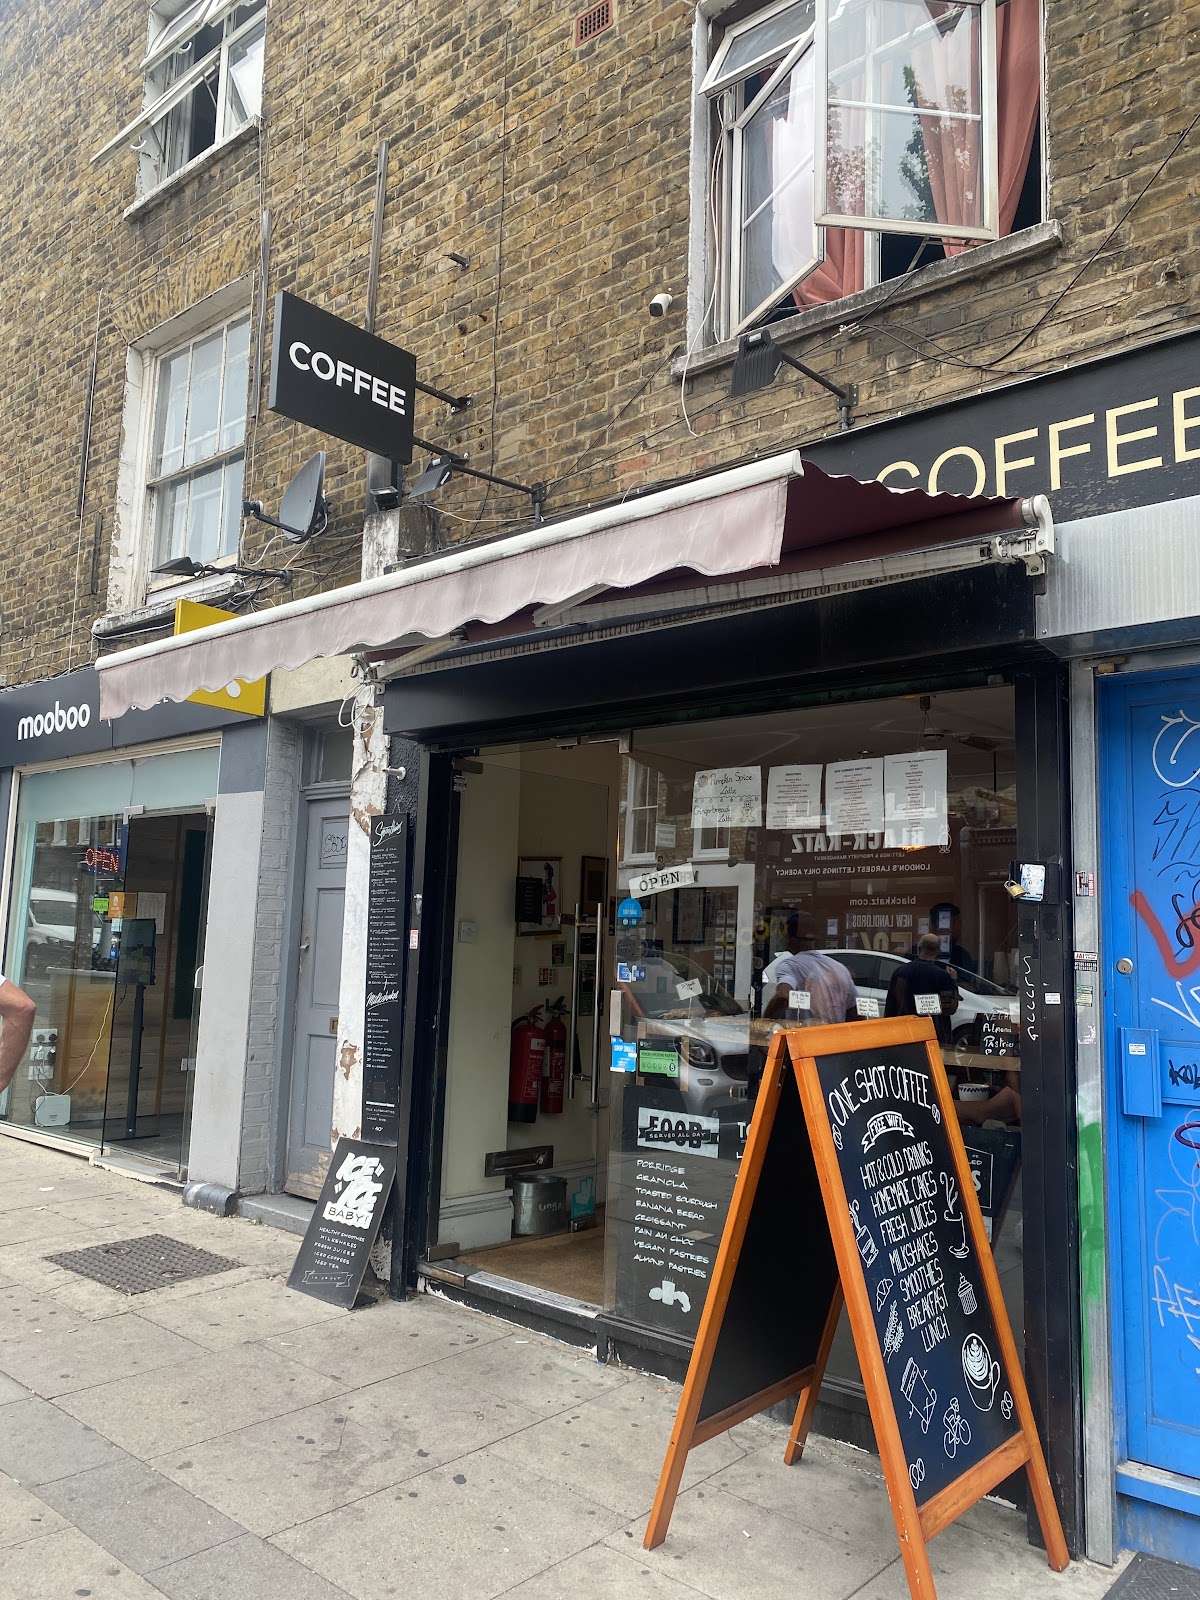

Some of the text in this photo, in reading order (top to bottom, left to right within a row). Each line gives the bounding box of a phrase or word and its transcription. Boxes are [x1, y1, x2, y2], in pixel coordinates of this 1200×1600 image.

[288, 340, 406, 417] COFFEE
[17, 701, 91, 741] mooboo
[709, 771, 752, 786] Pumpkin Spice
[720, 786, 736, 795] Latte
[85, 848, 119, 873] OPEN
[639, 871, 680, 892] OPEN
[828, 1065, 931, 1126] ONE SHOT COFFEE
[870, 1117, 886, 1137] FREE
[903, 1141, 934, 1171] DRINKS
[335, 1152, 380, 1182] ICE
[637, 1160, 685, 1175] PORRIDGE
[636, 1174, 688, 1190] GRANOLA
[337, 1181, 383, 1212] ICE
[636, 1187, 718, 1209] TOASTED SOURDOUGH
[870, 1178, 914, 1218] HOMEMADE
[911, 1170, 938, 1201] CAKES
[328, 1206, 369, 1225] BABY!
[636, 1200, 705, 1221] BANANA BREAD
[319, 1226, 341, 1237] HEALTHY
[634, 1214, 687, 1229] CROISSANT
[880, 1200, 938, 1246] FRESH JUICES
[320, 1234, 357, 1249] MILKSHAKES
[634, 1226, 652, 1237] PAIN
[670, 1236, 695, 1246] CHOC
[314, 1241, 355, 1257] FRESH JUICES
[314, 1251, 350, 1265] ICED COFFEES
[633, 1240, 710, 1264] VEGAN PASTRIES
[888, 1231, 939, 1276] MILKSHAKES
[315, 1259, 339, 1270] ICED TEA
[633, 1254, 707, 1279] ALMOND PASTRIES
[906, 1282, 949, 1330] BREAKFAST
[920, 1313, 951, 1353] LUNCH
